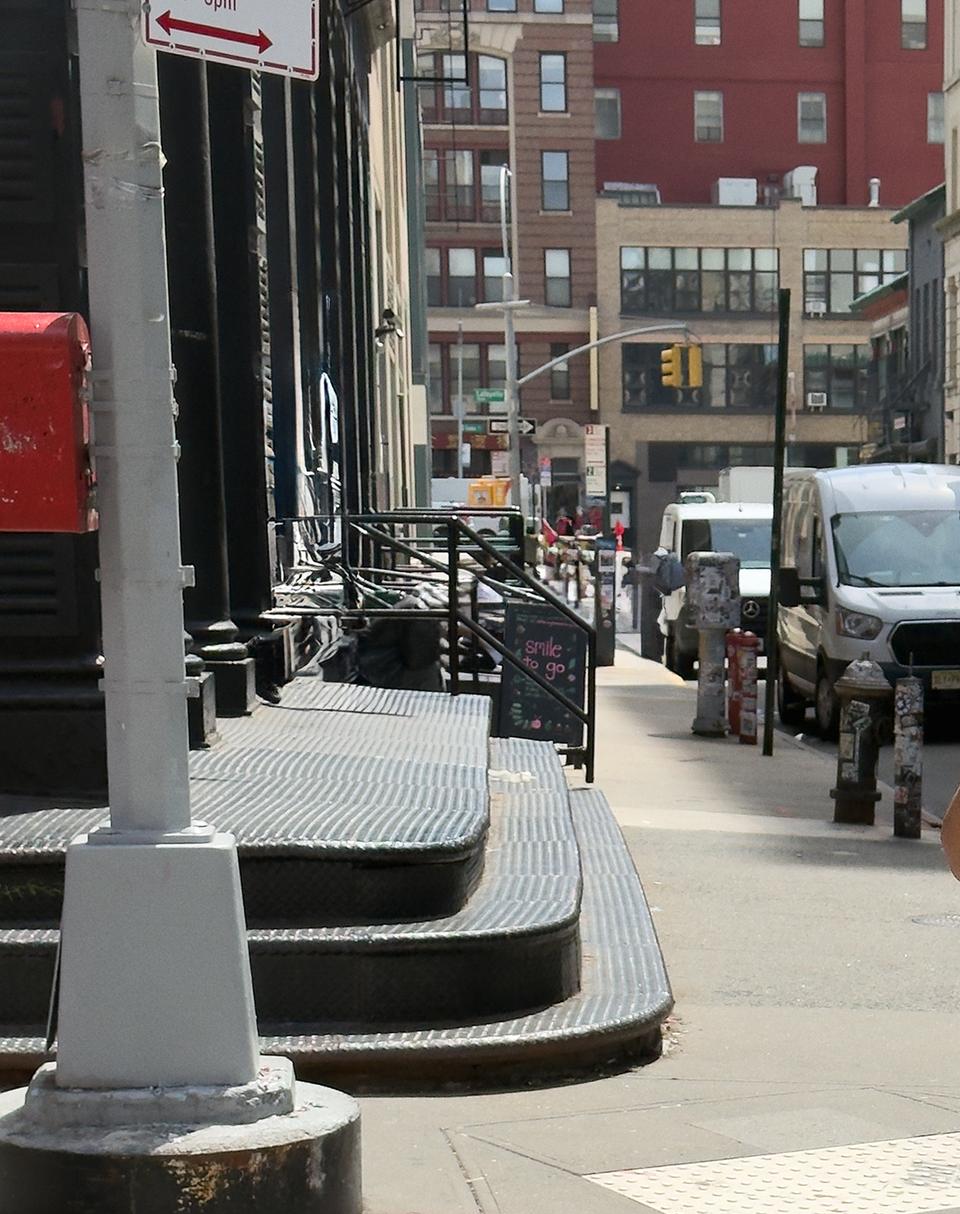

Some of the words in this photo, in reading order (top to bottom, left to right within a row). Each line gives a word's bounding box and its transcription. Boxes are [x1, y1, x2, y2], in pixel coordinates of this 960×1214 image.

[526, 637, 562, 657] smile
[523, 656, 539, 669] to
[545, 662, 565, 680] go
